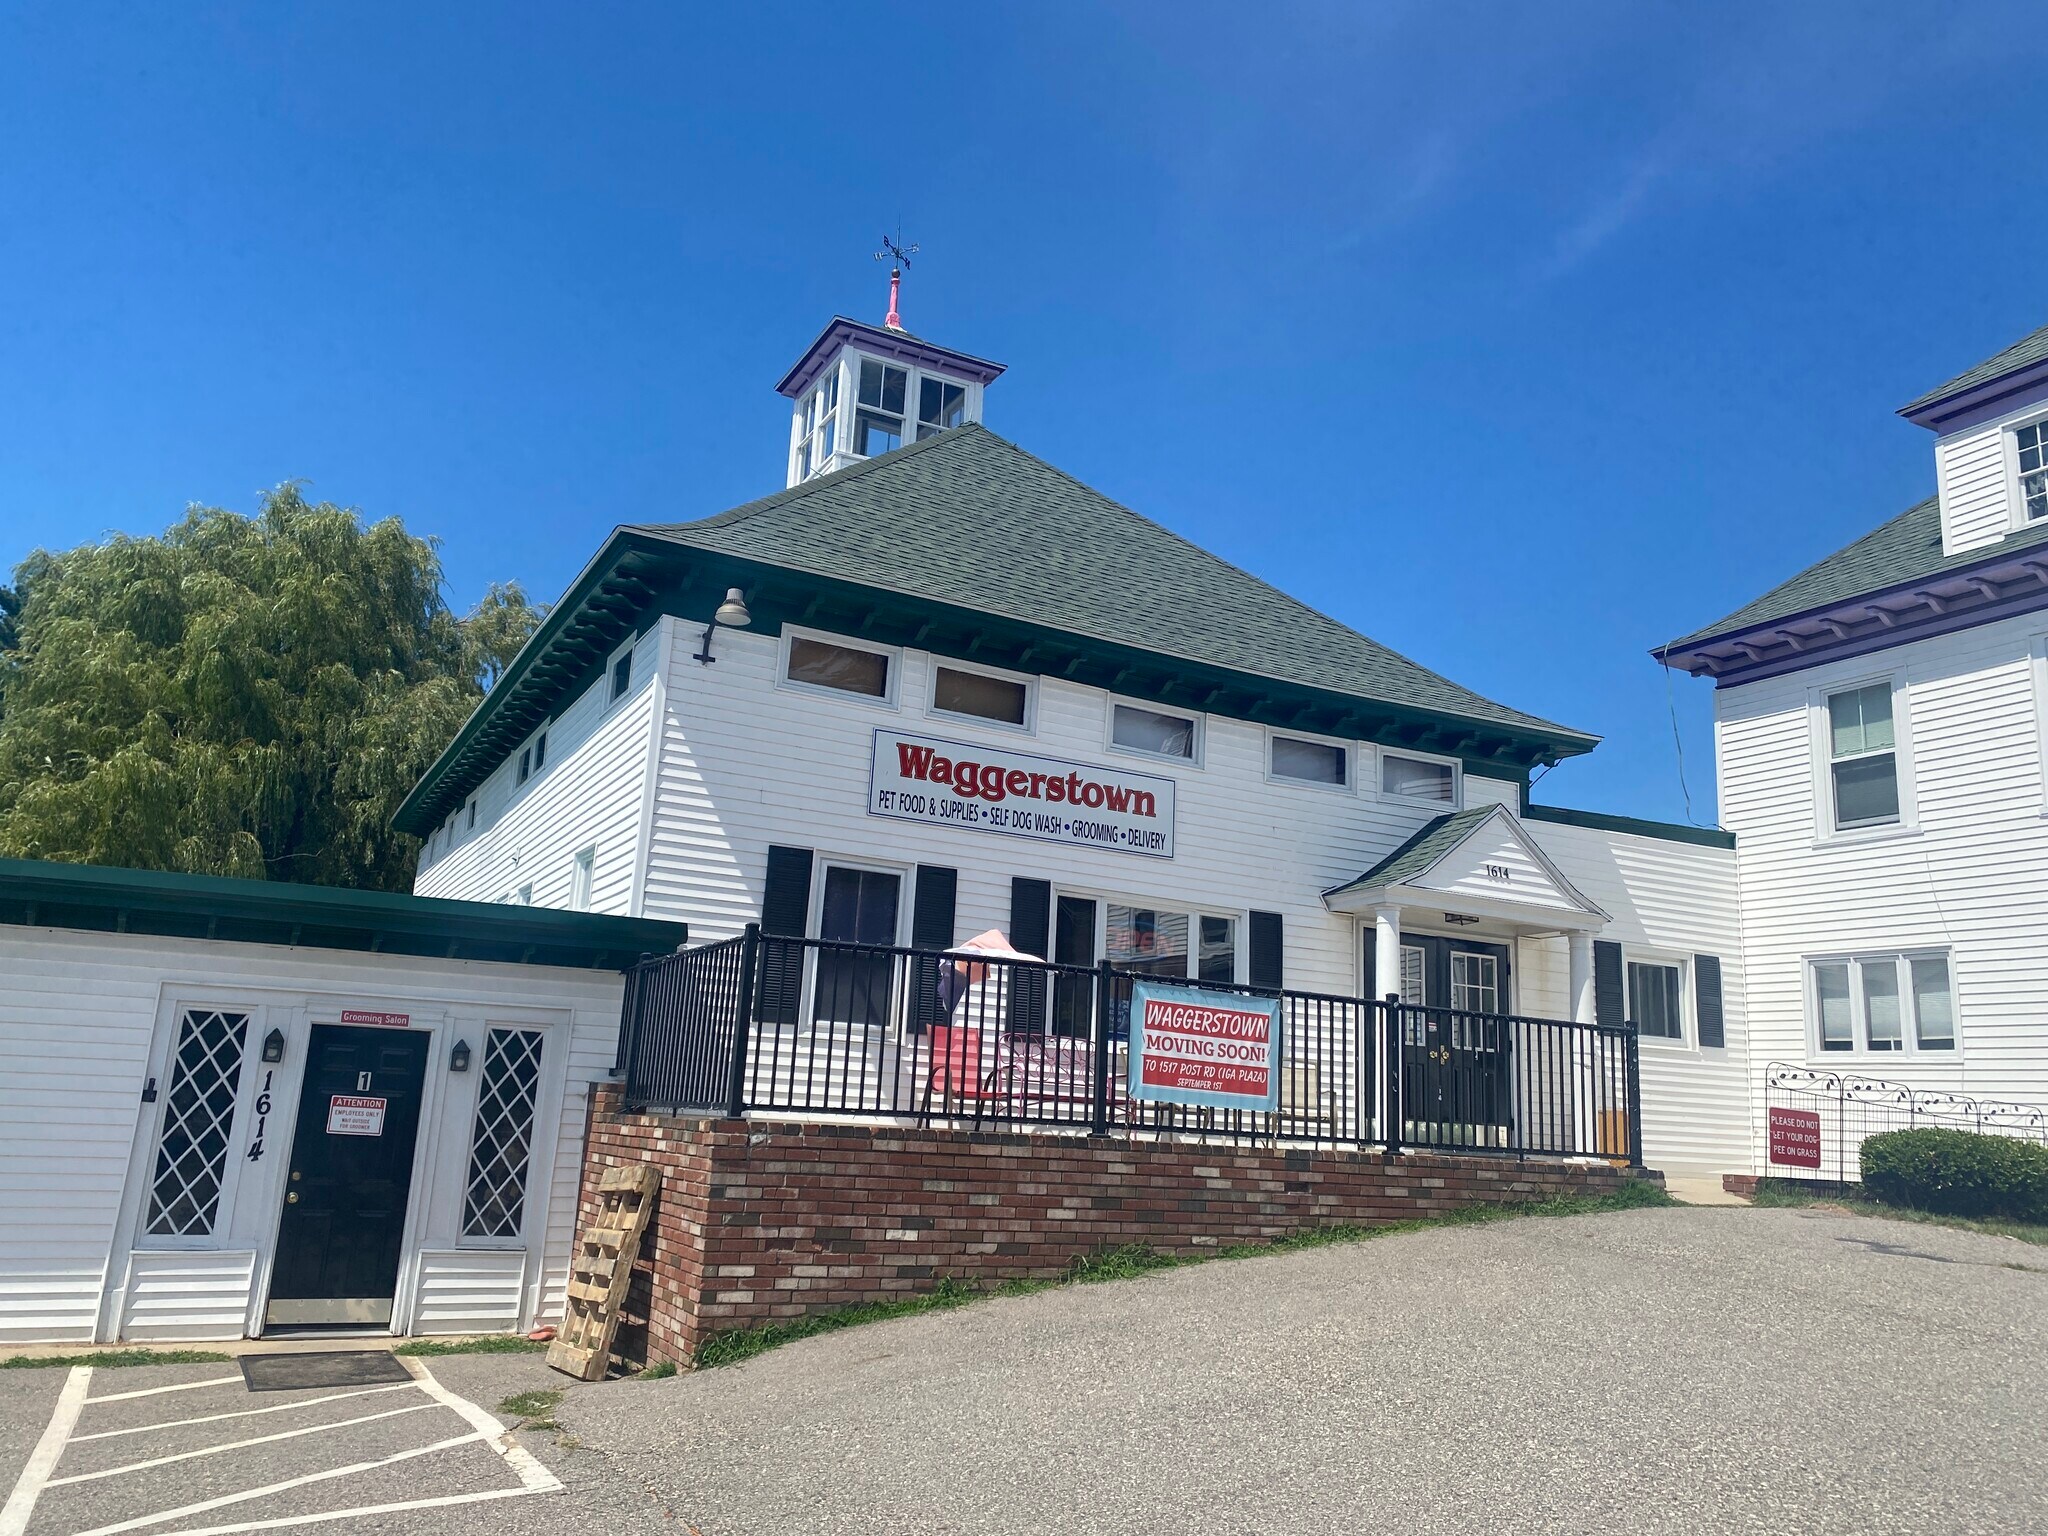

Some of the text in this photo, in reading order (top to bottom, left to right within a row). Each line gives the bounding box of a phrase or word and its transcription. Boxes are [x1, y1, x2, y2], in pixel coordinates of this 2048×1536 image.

[896, 742, 1157, 818] Waggerstown
[879, 789, 1166, 851] PET FOOD & SUPPLIES SELF DOG WASH GROOMING DELIVERY
[1486, 864, 1510, 880] 1614
[343, 1012, 407, 1025] Grooming Salon
[1147, 1003, 1268, 1039] WAGGERSTOWN
[1146, 1034, 1266, 1062] MOVING SOON!
[1145, 1059, 1267, 1084] TO 1517 POST RD (IGA PLAZA)
[361, 1073, 369, 1090] 1
[1212, 1081, 1223, 1091] 1ST
[336, 1098, 382, 1108] ATTENTION
[247, 1070, 273, 1162] 1614
[334, 1109, 365, 1117] EMPLOYEES
[1771, 1115, 1818, 1130] PLEASE DO NOT
[1786, 1132, 1803, 1142] YOUR
[1804, 1134, 1817, 1144] DOG
[1773, 1144, 1818, 1158] PEE ON GRASS
